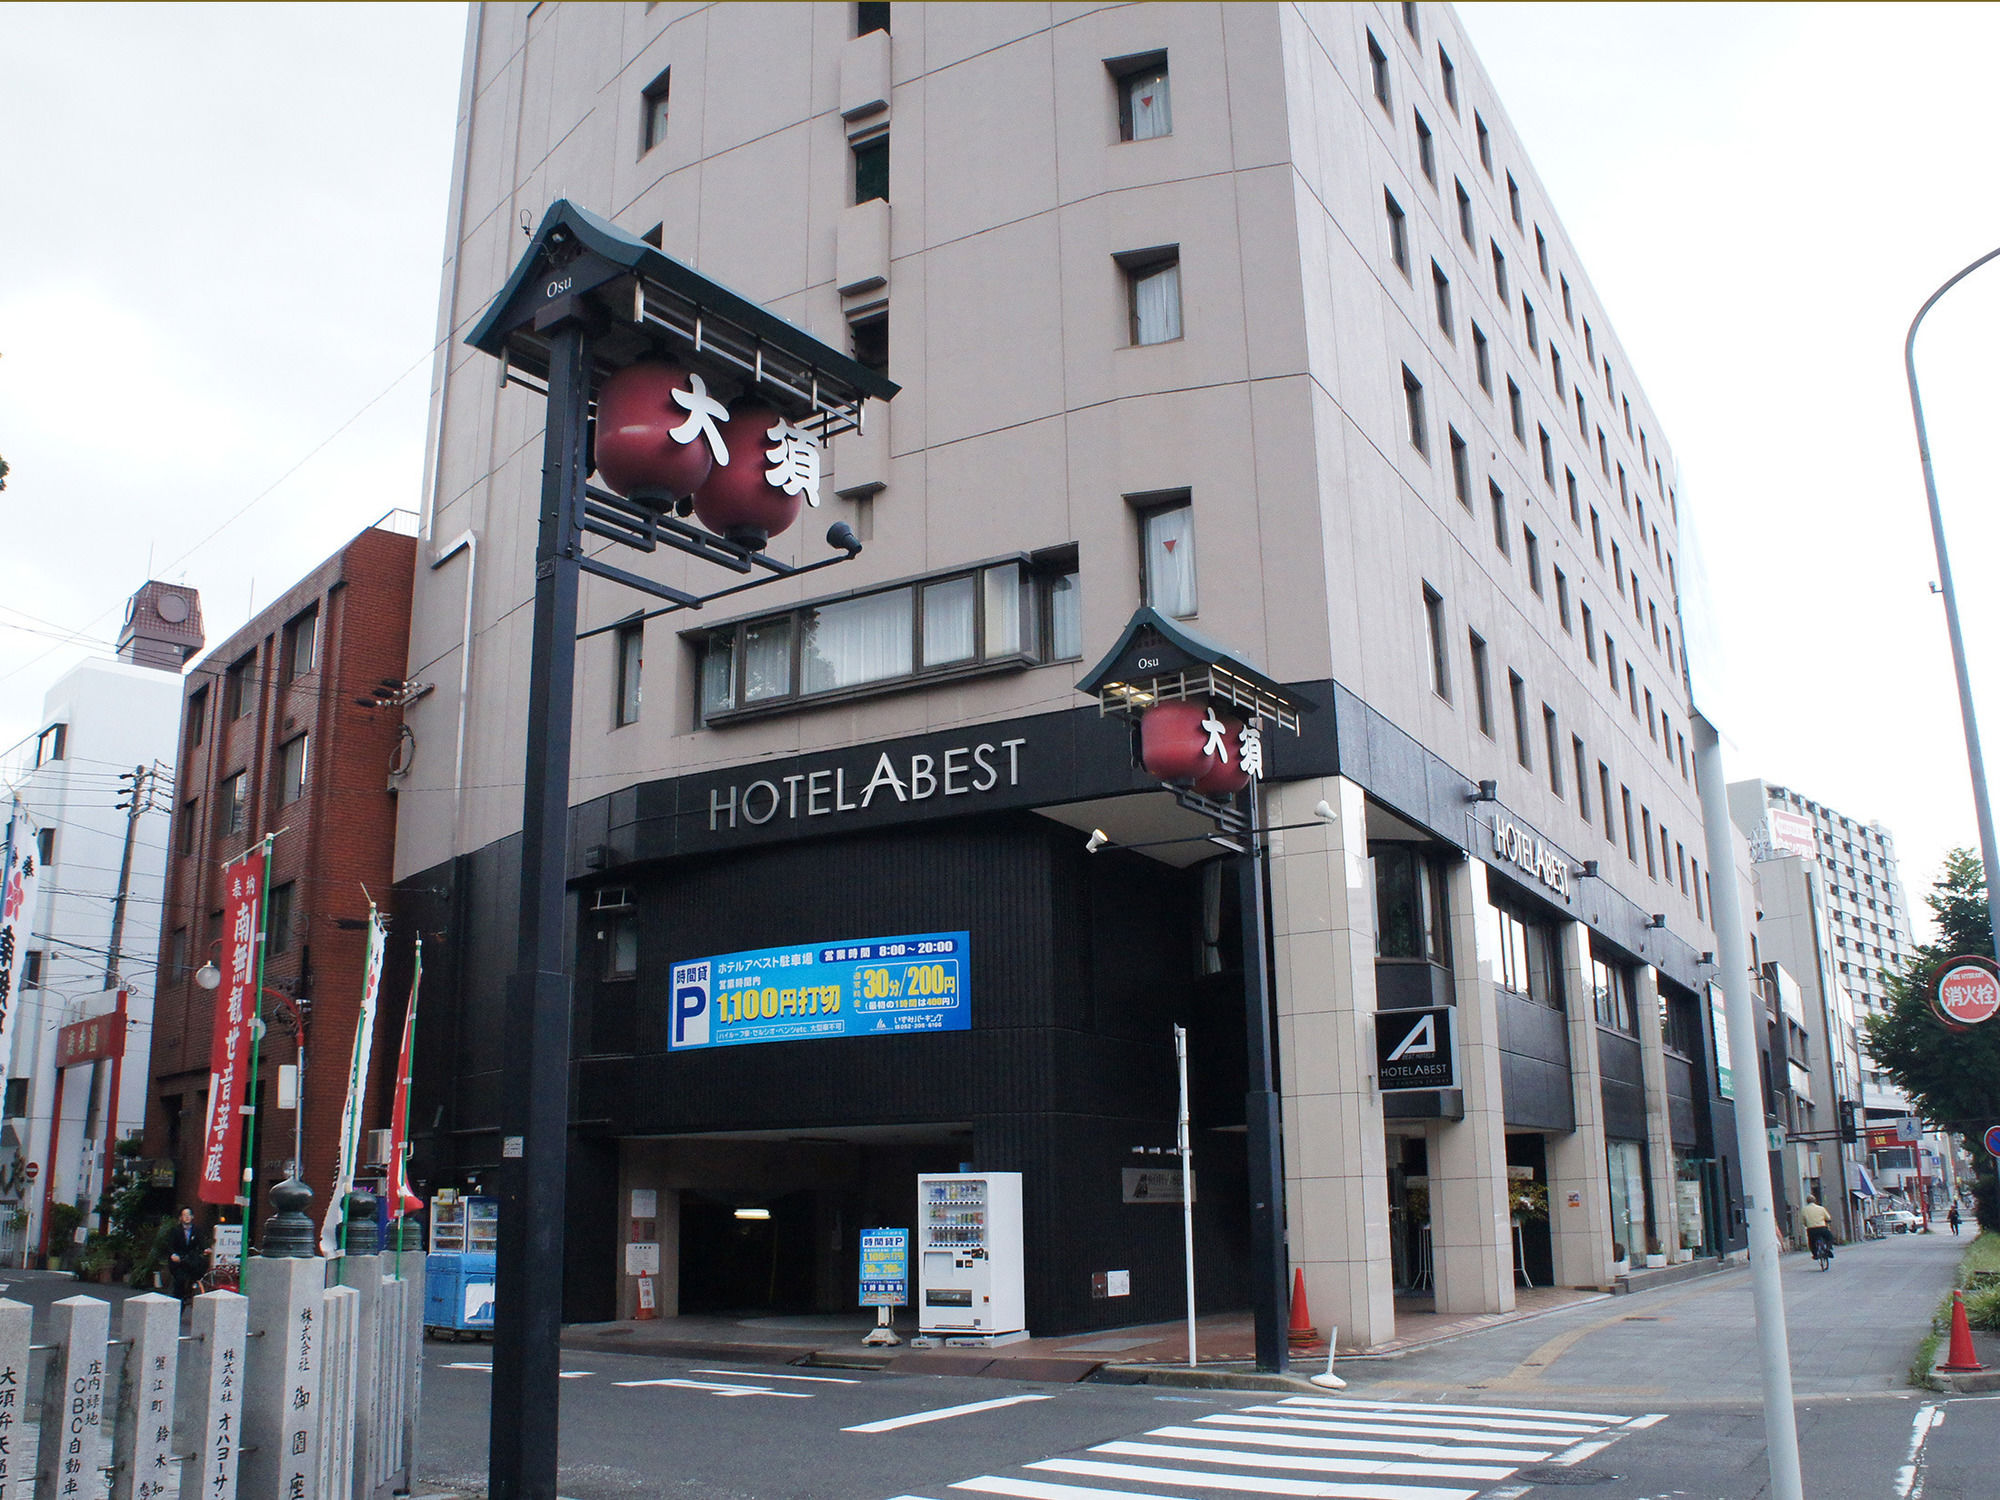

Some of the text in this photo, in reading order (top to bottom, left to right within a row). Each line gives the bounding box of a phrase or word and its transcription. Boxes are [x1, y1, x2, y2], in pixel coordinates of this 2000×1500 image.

[547, 277, 572, 298] Osu
[669, 373, 820, 508] 大須
[1138, 657, 1159, 670] Osu
[1201, 706, 1263, 779] 大須
[231, 875, 256, 900] 奉納
[676, 965, 708, 984] 時間貸
[1944, 983, 1995, 1007] 消火栓
[676, 986, 706, 1042] P
[716, 985, 841, 1025] 1,100円打切
[298, 1307, 314, 1371] 株式会社
[220, 1348, 236, 1403] 株式会社
[62, 1377, 86, 1500] CBC自動車
